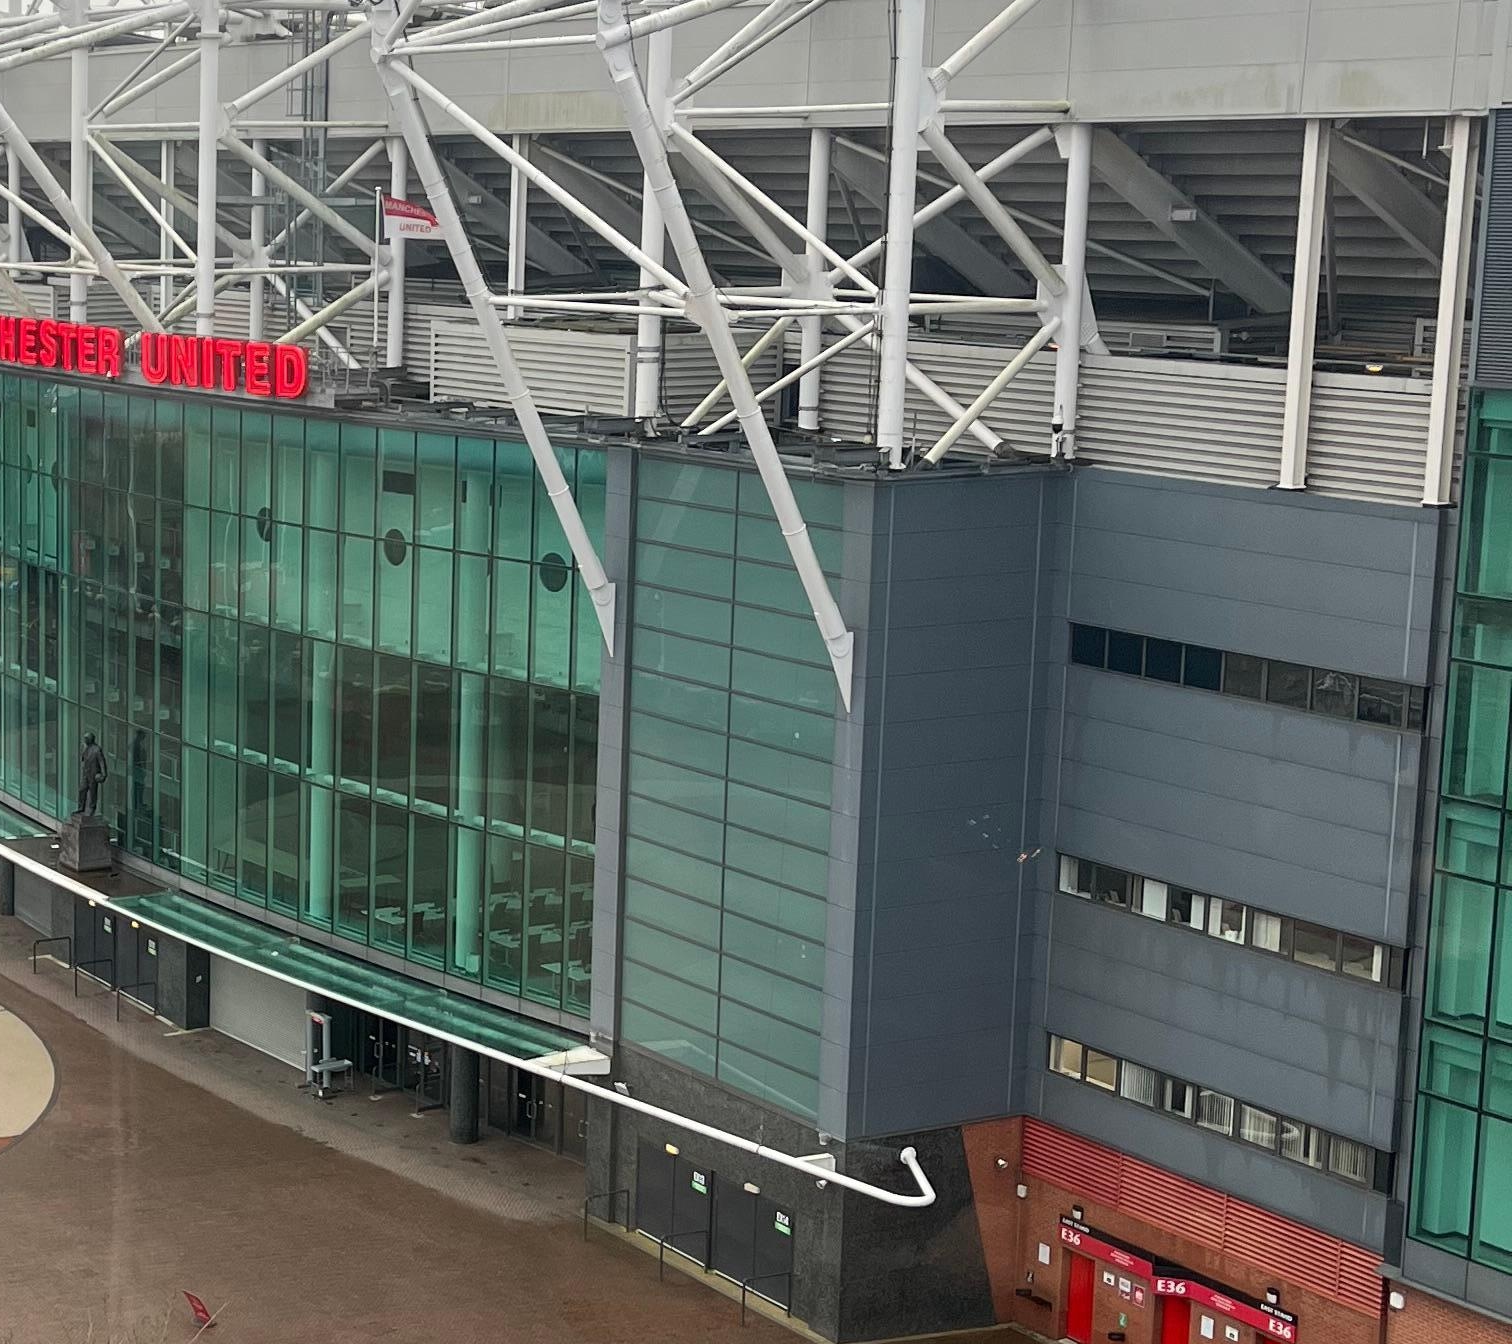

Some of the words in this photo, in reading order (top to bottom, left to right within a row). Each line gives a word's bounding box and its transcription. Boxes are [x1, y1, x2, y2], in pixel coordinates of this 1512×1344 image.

[399, 222, 432, 234] UNITED
[140, 331, 308, 399] UNITED
[1061, 1227, 1081, 1246] E36
[1157, 1279, 1186, 1294] E36
[1268, 1318, 1292, 1339] E36
